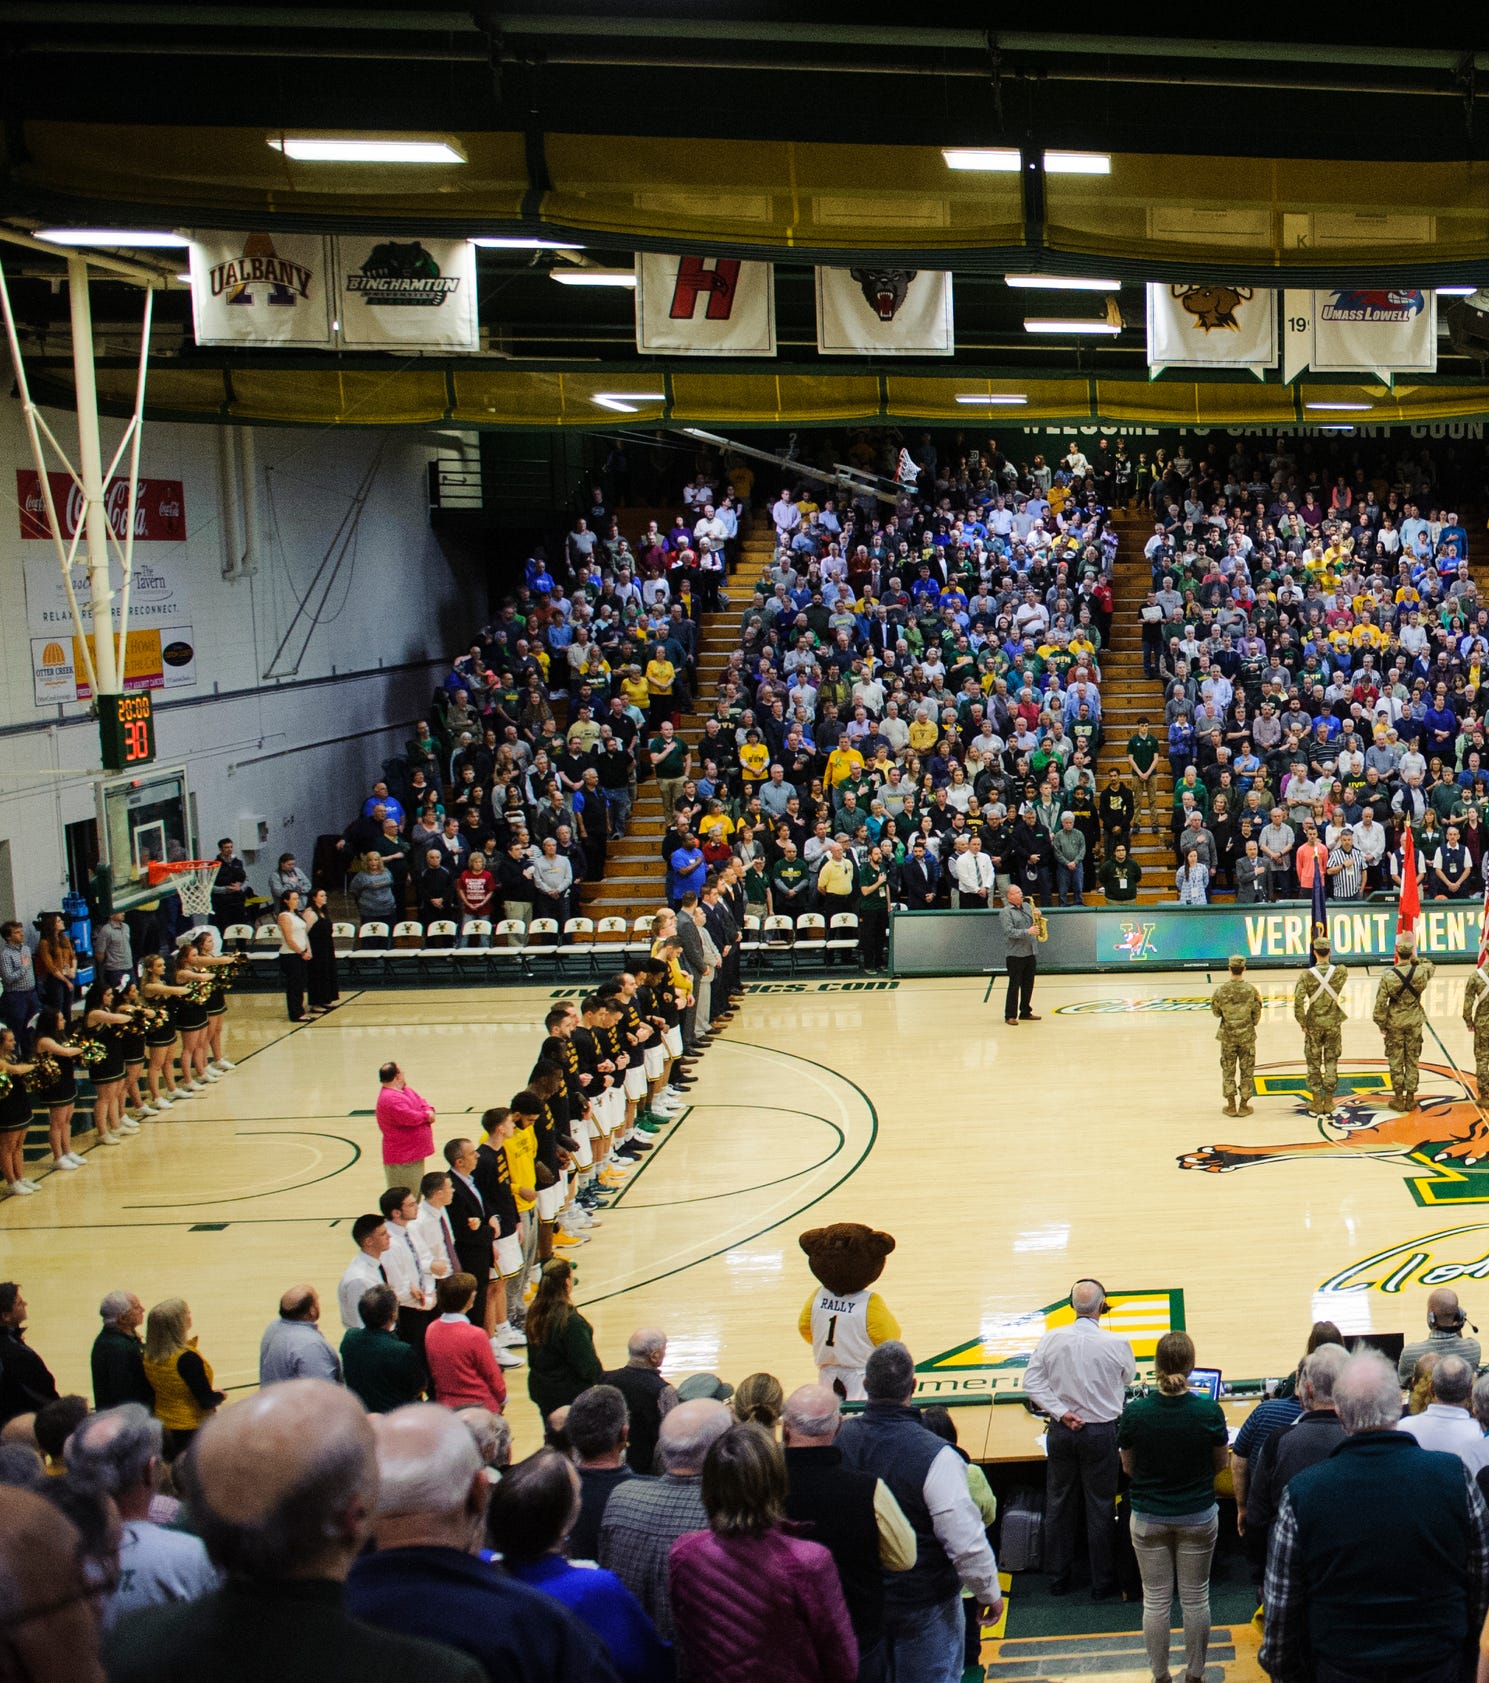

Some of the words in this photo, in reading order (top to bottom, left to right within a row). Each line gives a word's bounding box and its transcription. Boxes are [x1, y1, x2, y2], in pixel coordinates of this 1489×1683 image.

[209, 257, 313, 299] UALBANY
[347, 277, 460, 292] BINGHAMTON
[1322, 305, 1364, 321] UMASS
[118, 697, 150, 722] 20:00
[124, 719, 149, 761] 30
[820, 1298, 856, 1314] RALLY
[826, 1314, 838, 1348] 1
